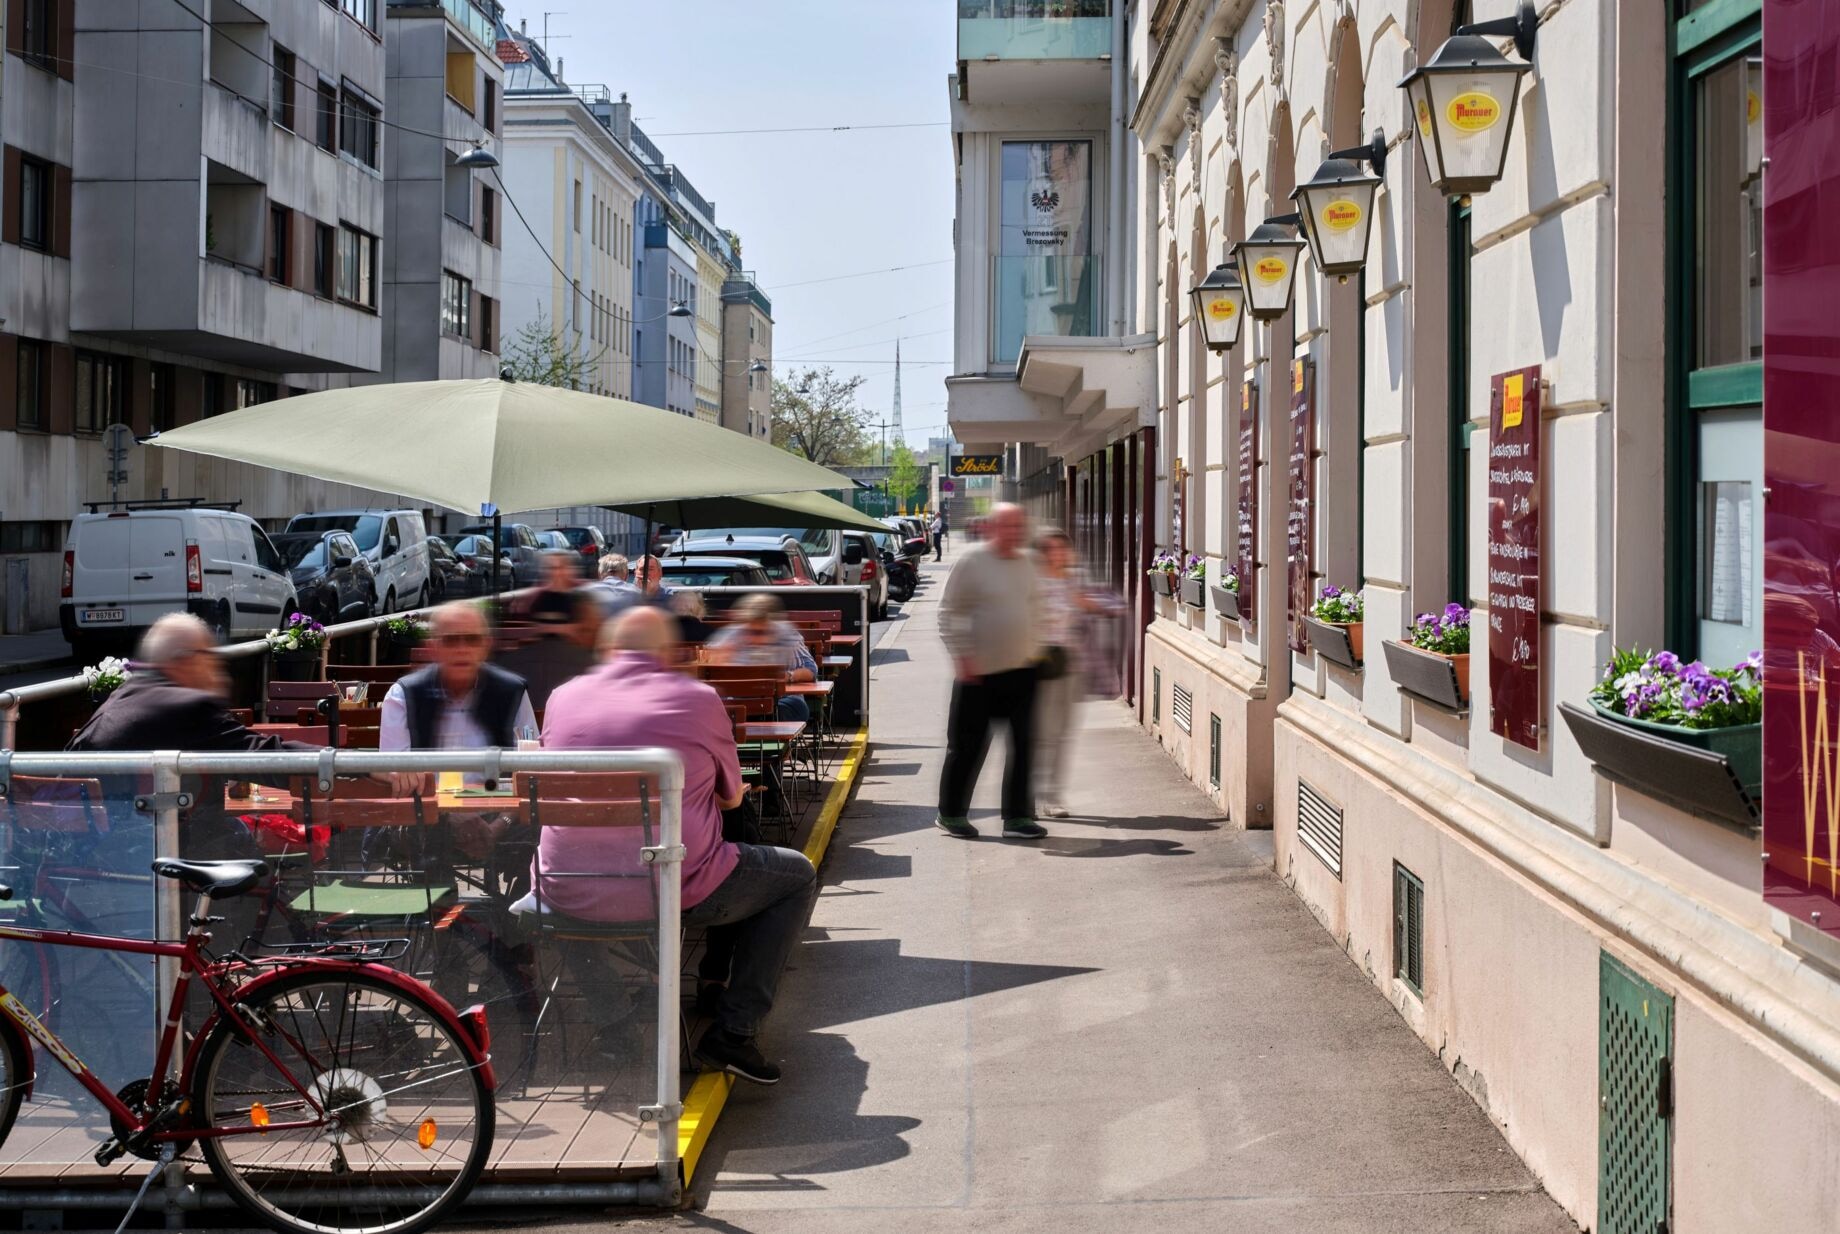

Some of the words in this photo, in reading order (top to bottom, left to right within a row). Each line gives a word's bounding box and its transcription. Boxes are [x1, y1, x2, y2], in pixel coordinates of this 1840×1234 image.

[1455, 103, 1493, 121] Murauer
[1022, 230, 1068, 238] Vermessung
[1026, 238, 1065, 246] Brezovsky
[955, 457, 998, 473] Ströck
